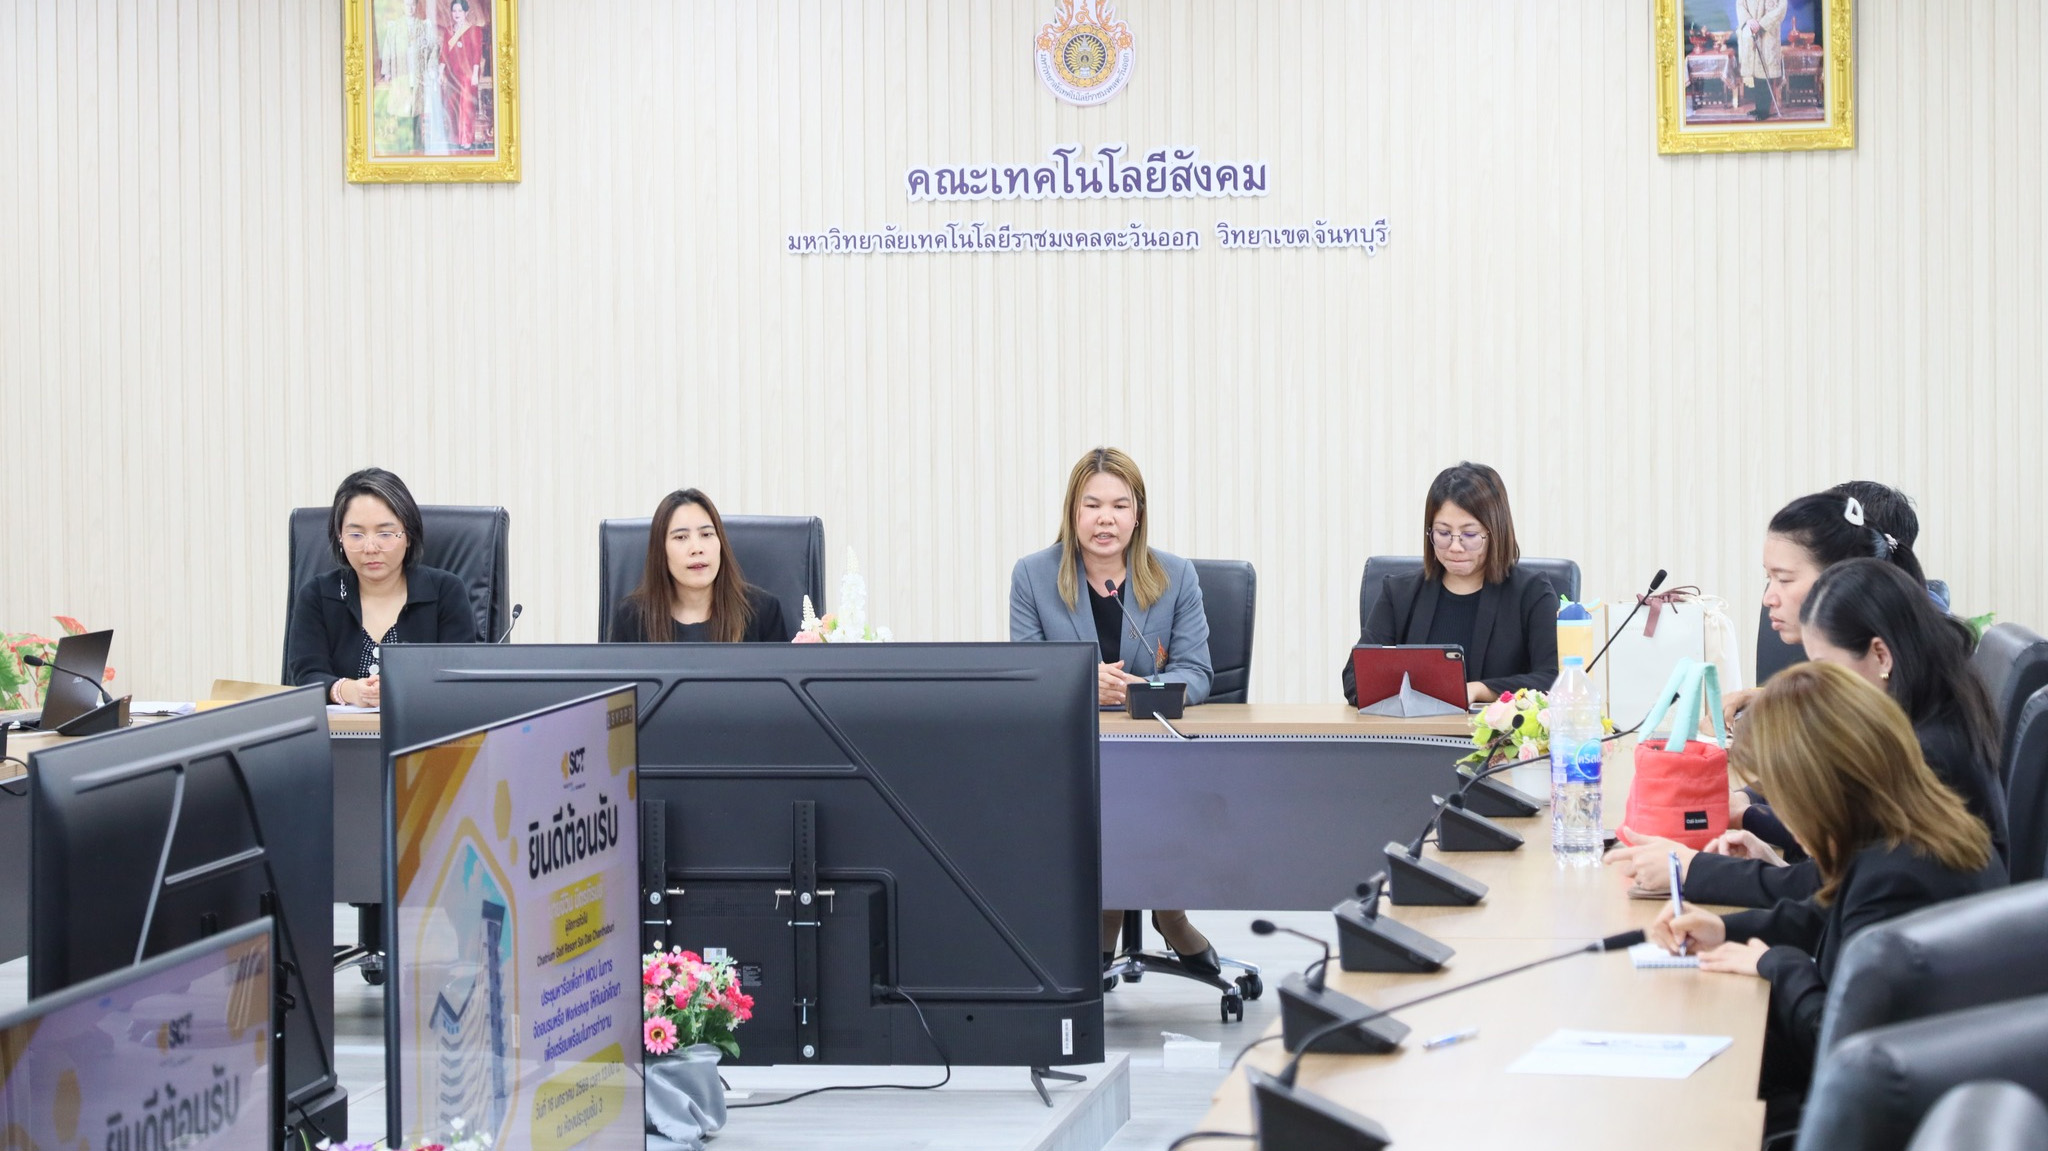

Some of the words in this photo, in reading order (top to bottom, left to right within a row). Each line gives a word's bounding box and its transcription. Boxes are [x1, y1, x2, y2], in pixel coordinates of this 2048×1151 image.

[907, 147, 1267, 196] คณะเทคโนโลยีสังคม
[787, 222, 1199, 251] มหาวิทยาลัยเทคโนโลยีราชมงคลตะวันออก
[569, 747, 586, 775] SCT
[529, 793, 618, 879] ยินดีต้อนรับ
[586, 964, 598, 983] MOU
[565, 1001, 589, 1023] Workshop
